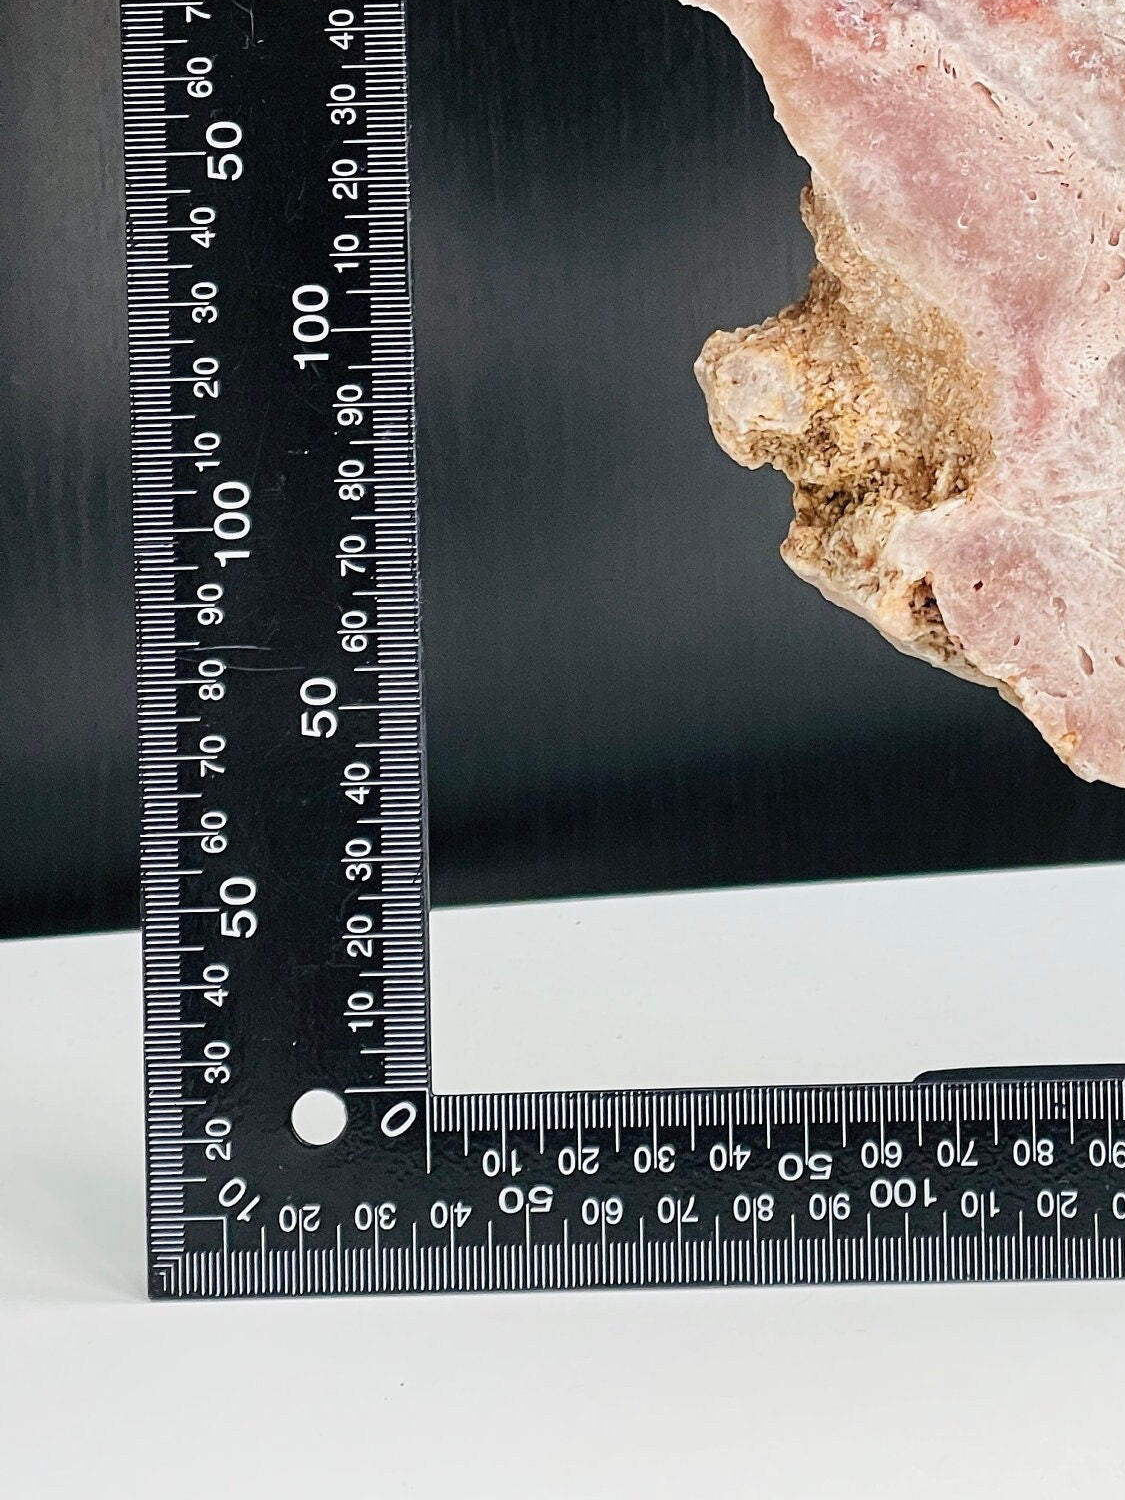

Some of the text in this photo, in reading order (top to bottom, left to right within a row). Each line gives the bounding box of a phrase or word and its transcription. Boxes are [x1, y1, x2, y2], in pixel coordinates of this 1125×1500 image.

[328, 8, 354, 50] 40
[188, 57, 213, 98] 60
[330, 83, 356, 125] 30
[205, 121, 243, 181] 50
[332, 158, 358, 200] 20
[190, 207, 216, 248] 40
[333, 233, 359, 273] 10
[191, 282, 218, 324] 30
[293, 284, 330, 370] 100
[193, 358, 220, 398] 20
[336, 384, 363, 426] 90
[194, 432, 221, 472] 10
[338, 459, 365, 501] 80
[213, 481, 250, 568] 100
[340, 535, 366, 576] 70
[197, 584, 224, 625] 90
[341, 610, 368, 652] 60
[198, 659, 225, 701] 80
[300, 676, 338, 738] 50
[199, 735, 226, 777] 70
[344, 762, 370, 804] 40
[200, 811, 228, 853] 60
[345, 838, 373, 881] 30
[219, 877, 258, 939] 50
[347, 915, 374, 957] 20
[203, 963, 229, 1007] 40
[347, 990, 374, 1032] 10
[203, 1041, 231, 1084] 30
[205, 1119, 232, 1161] 20
[381, 1102, 416, 1139] 0
[482, 1150, 521, 1177] 10
[558, 1148, 601, 1175] 20
[633, 1146, 676, 1173] 30
[708, 1144, 751, 1171] 40
[778, 1153, 833, 1180] 50
[860, 1141, 902, 1169] 60
[936, 1139, 979, 1168] 70
[1013, 1138, 1055, 1167] 80
[217, 1177, 261, 1223] 10
[429, 1201, 472, 1228] 40
[499, 1186, 555, 1214] 50
[581, 1198, 624, 1225] 60
[656, 1196, 698, 1223] 70
[732, 1194, 774, 1222] 80
[808, 1193, 851, 1221] 90
[871, 1179, 939, 1209] 100
[960, 1188, 1001, 1218] 10
[1036, 1188, 1078, 1218] 20
[278, 1204, 321, 1232] 20
[354, 1202, 396, 1231] 30
